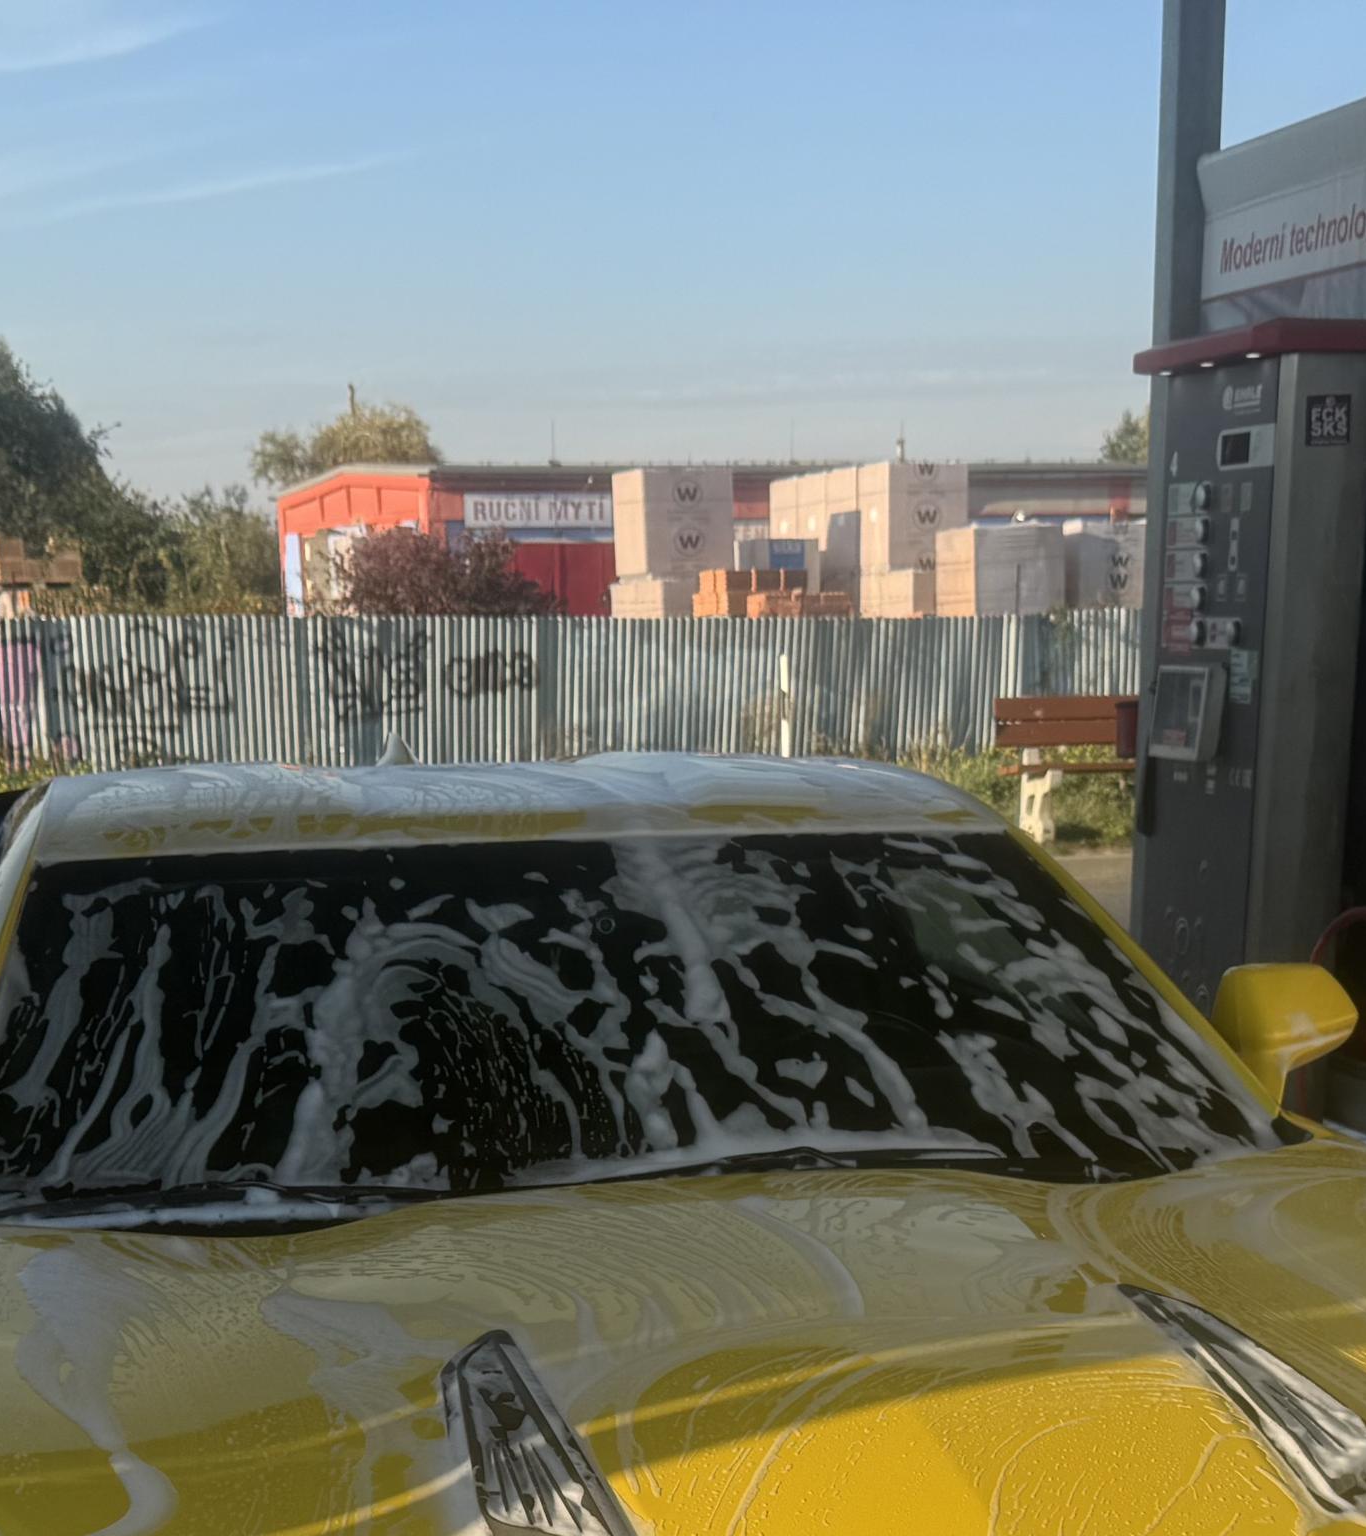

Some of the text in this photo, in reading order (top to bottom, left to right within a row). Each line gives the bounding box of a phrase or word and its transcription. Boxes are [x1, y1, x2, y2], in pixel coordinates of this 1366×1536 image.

[1311, 406, 1348, 422] FCK
[1311, 421, 1348, 437] SKS
[677, 487, 698, 502] W
[917, 510, 937, 524] W
[679, 535, 700, 550] W
[1109, 574, 1128, 589] W
